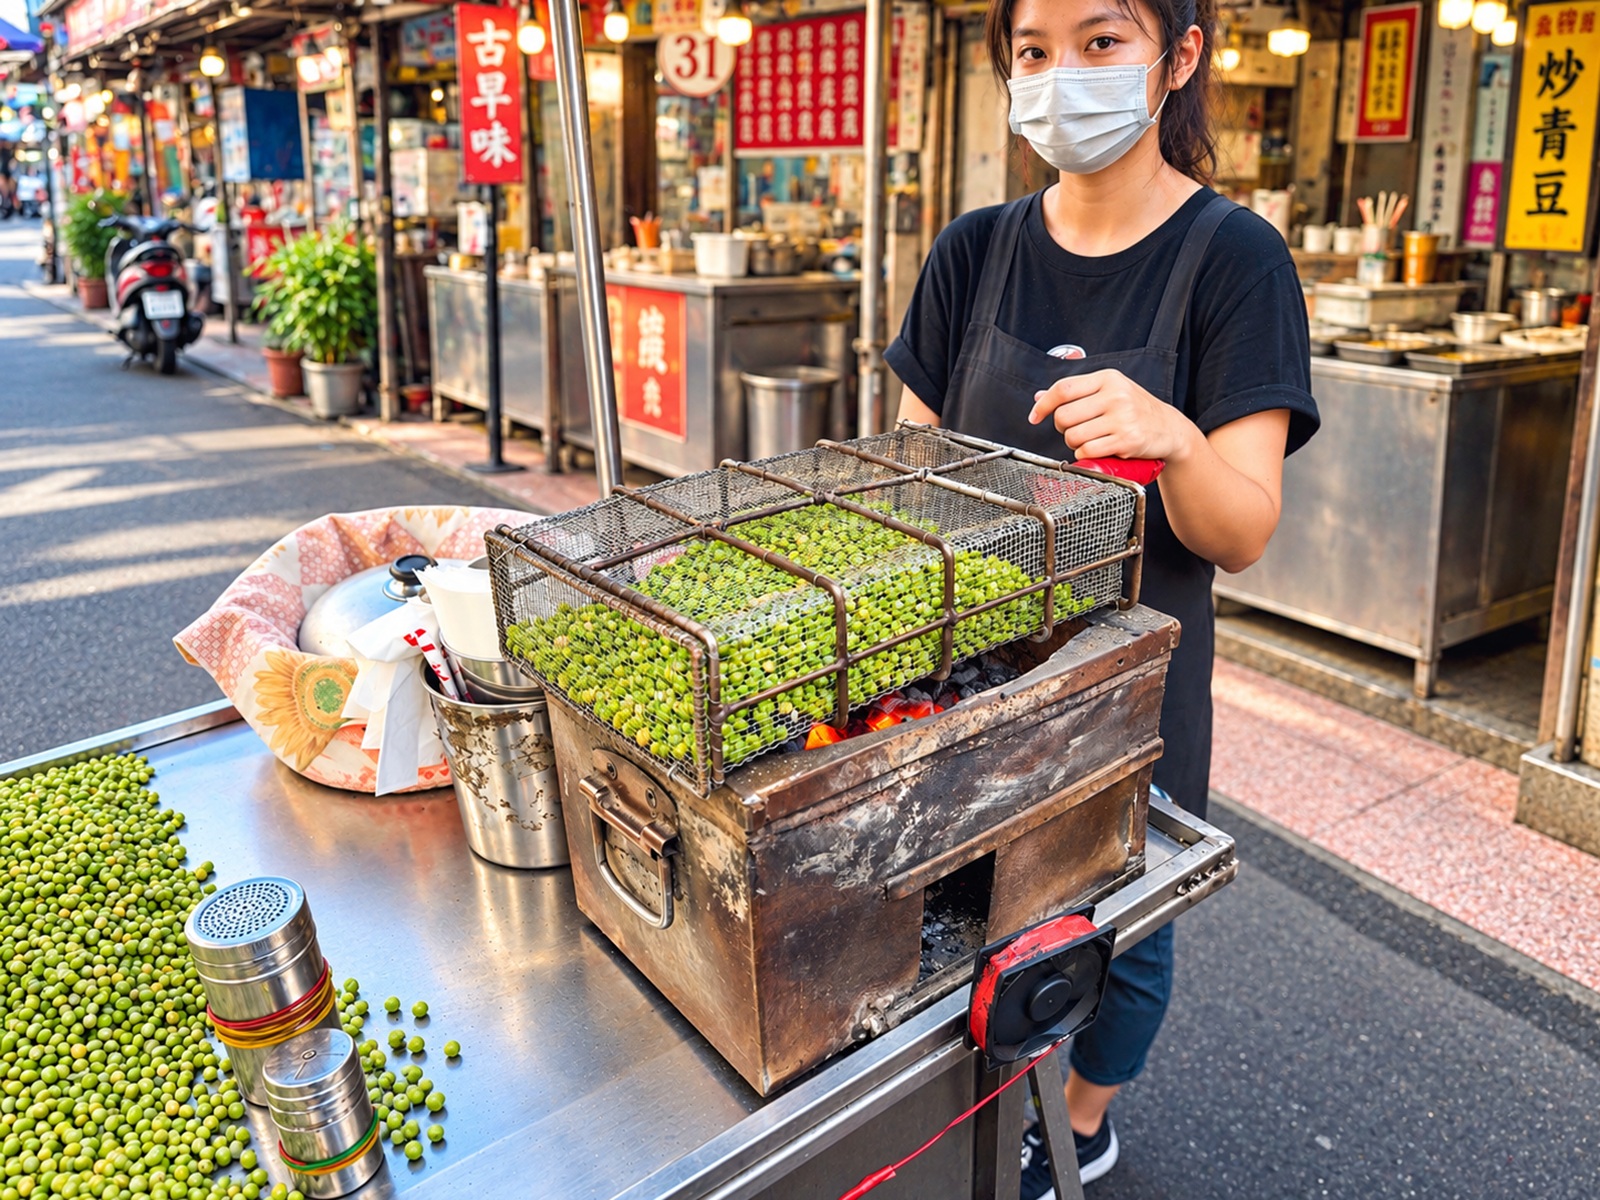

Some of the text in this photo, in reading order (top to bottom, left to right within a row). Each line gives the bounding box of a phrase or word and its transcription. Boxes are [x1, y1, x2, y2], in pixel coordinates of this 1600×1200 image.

[466, 18, 517, 168] 古早味
[674, 34, 717, 79] 31
[1526, 48, 1584, 216] 炒青豆
